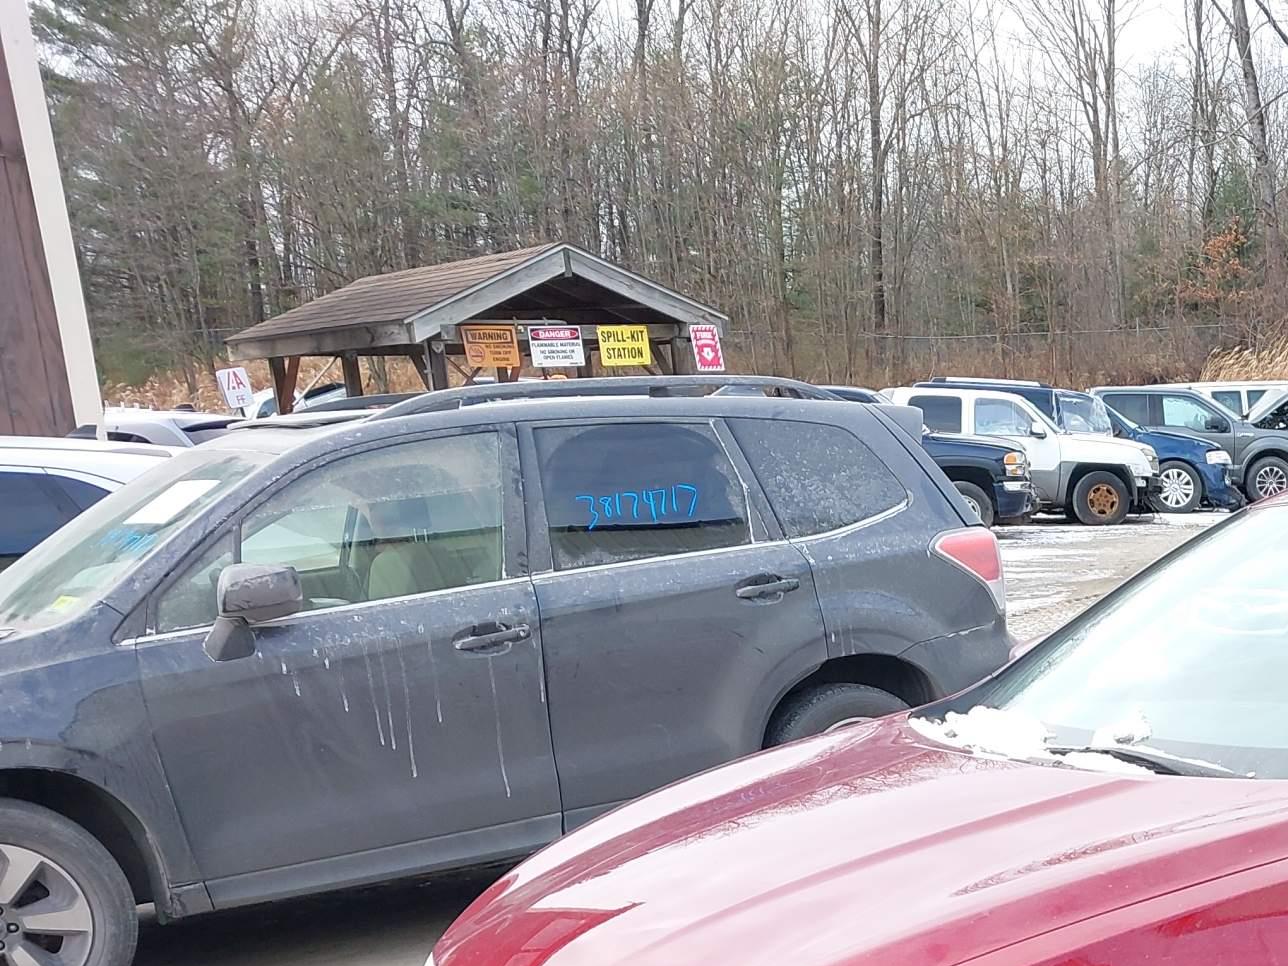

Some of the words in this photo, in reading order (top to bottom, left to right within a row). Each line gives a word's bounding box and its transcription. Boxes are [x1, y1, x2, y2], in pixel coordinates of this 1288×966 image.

[470, 331, 509, 341] WARNING
[539, 330, 571, 338] DANGER
[600, 330, 645, 343] SPILL-KIT
[606, 346, 644, 360] STATION
[575, 483, 698, 530] 38174717
